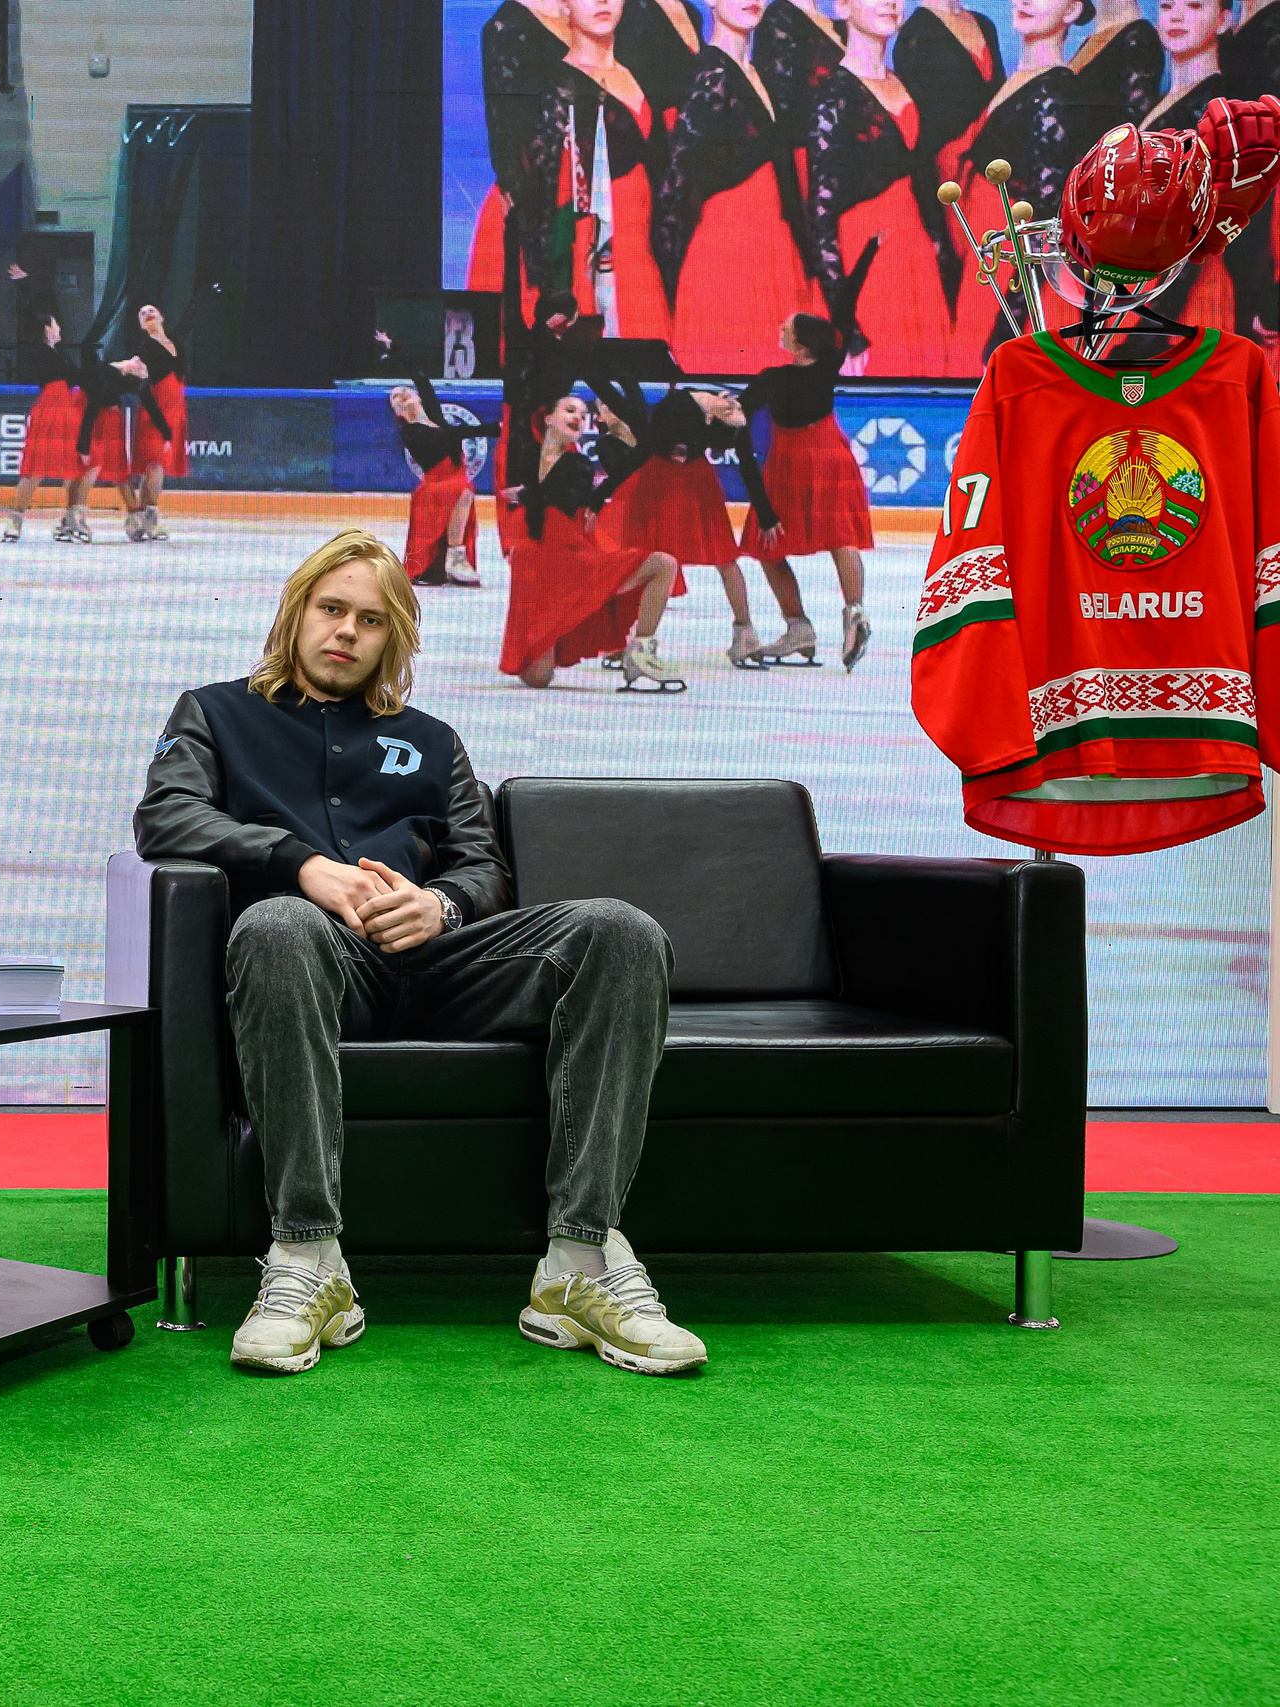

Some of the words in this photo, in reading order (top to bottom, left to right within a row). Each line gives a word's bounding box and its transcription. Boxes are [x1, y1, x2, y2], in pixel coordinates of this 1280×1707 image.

[1103, 146, 1116, 201] CCM
[1095, 268, 1151, 282] HOCKEY.BY
[1109, 545, 1155, 557] БЕЛАРУСЬ
[1079, 591, 1204, 620] BELARUS
